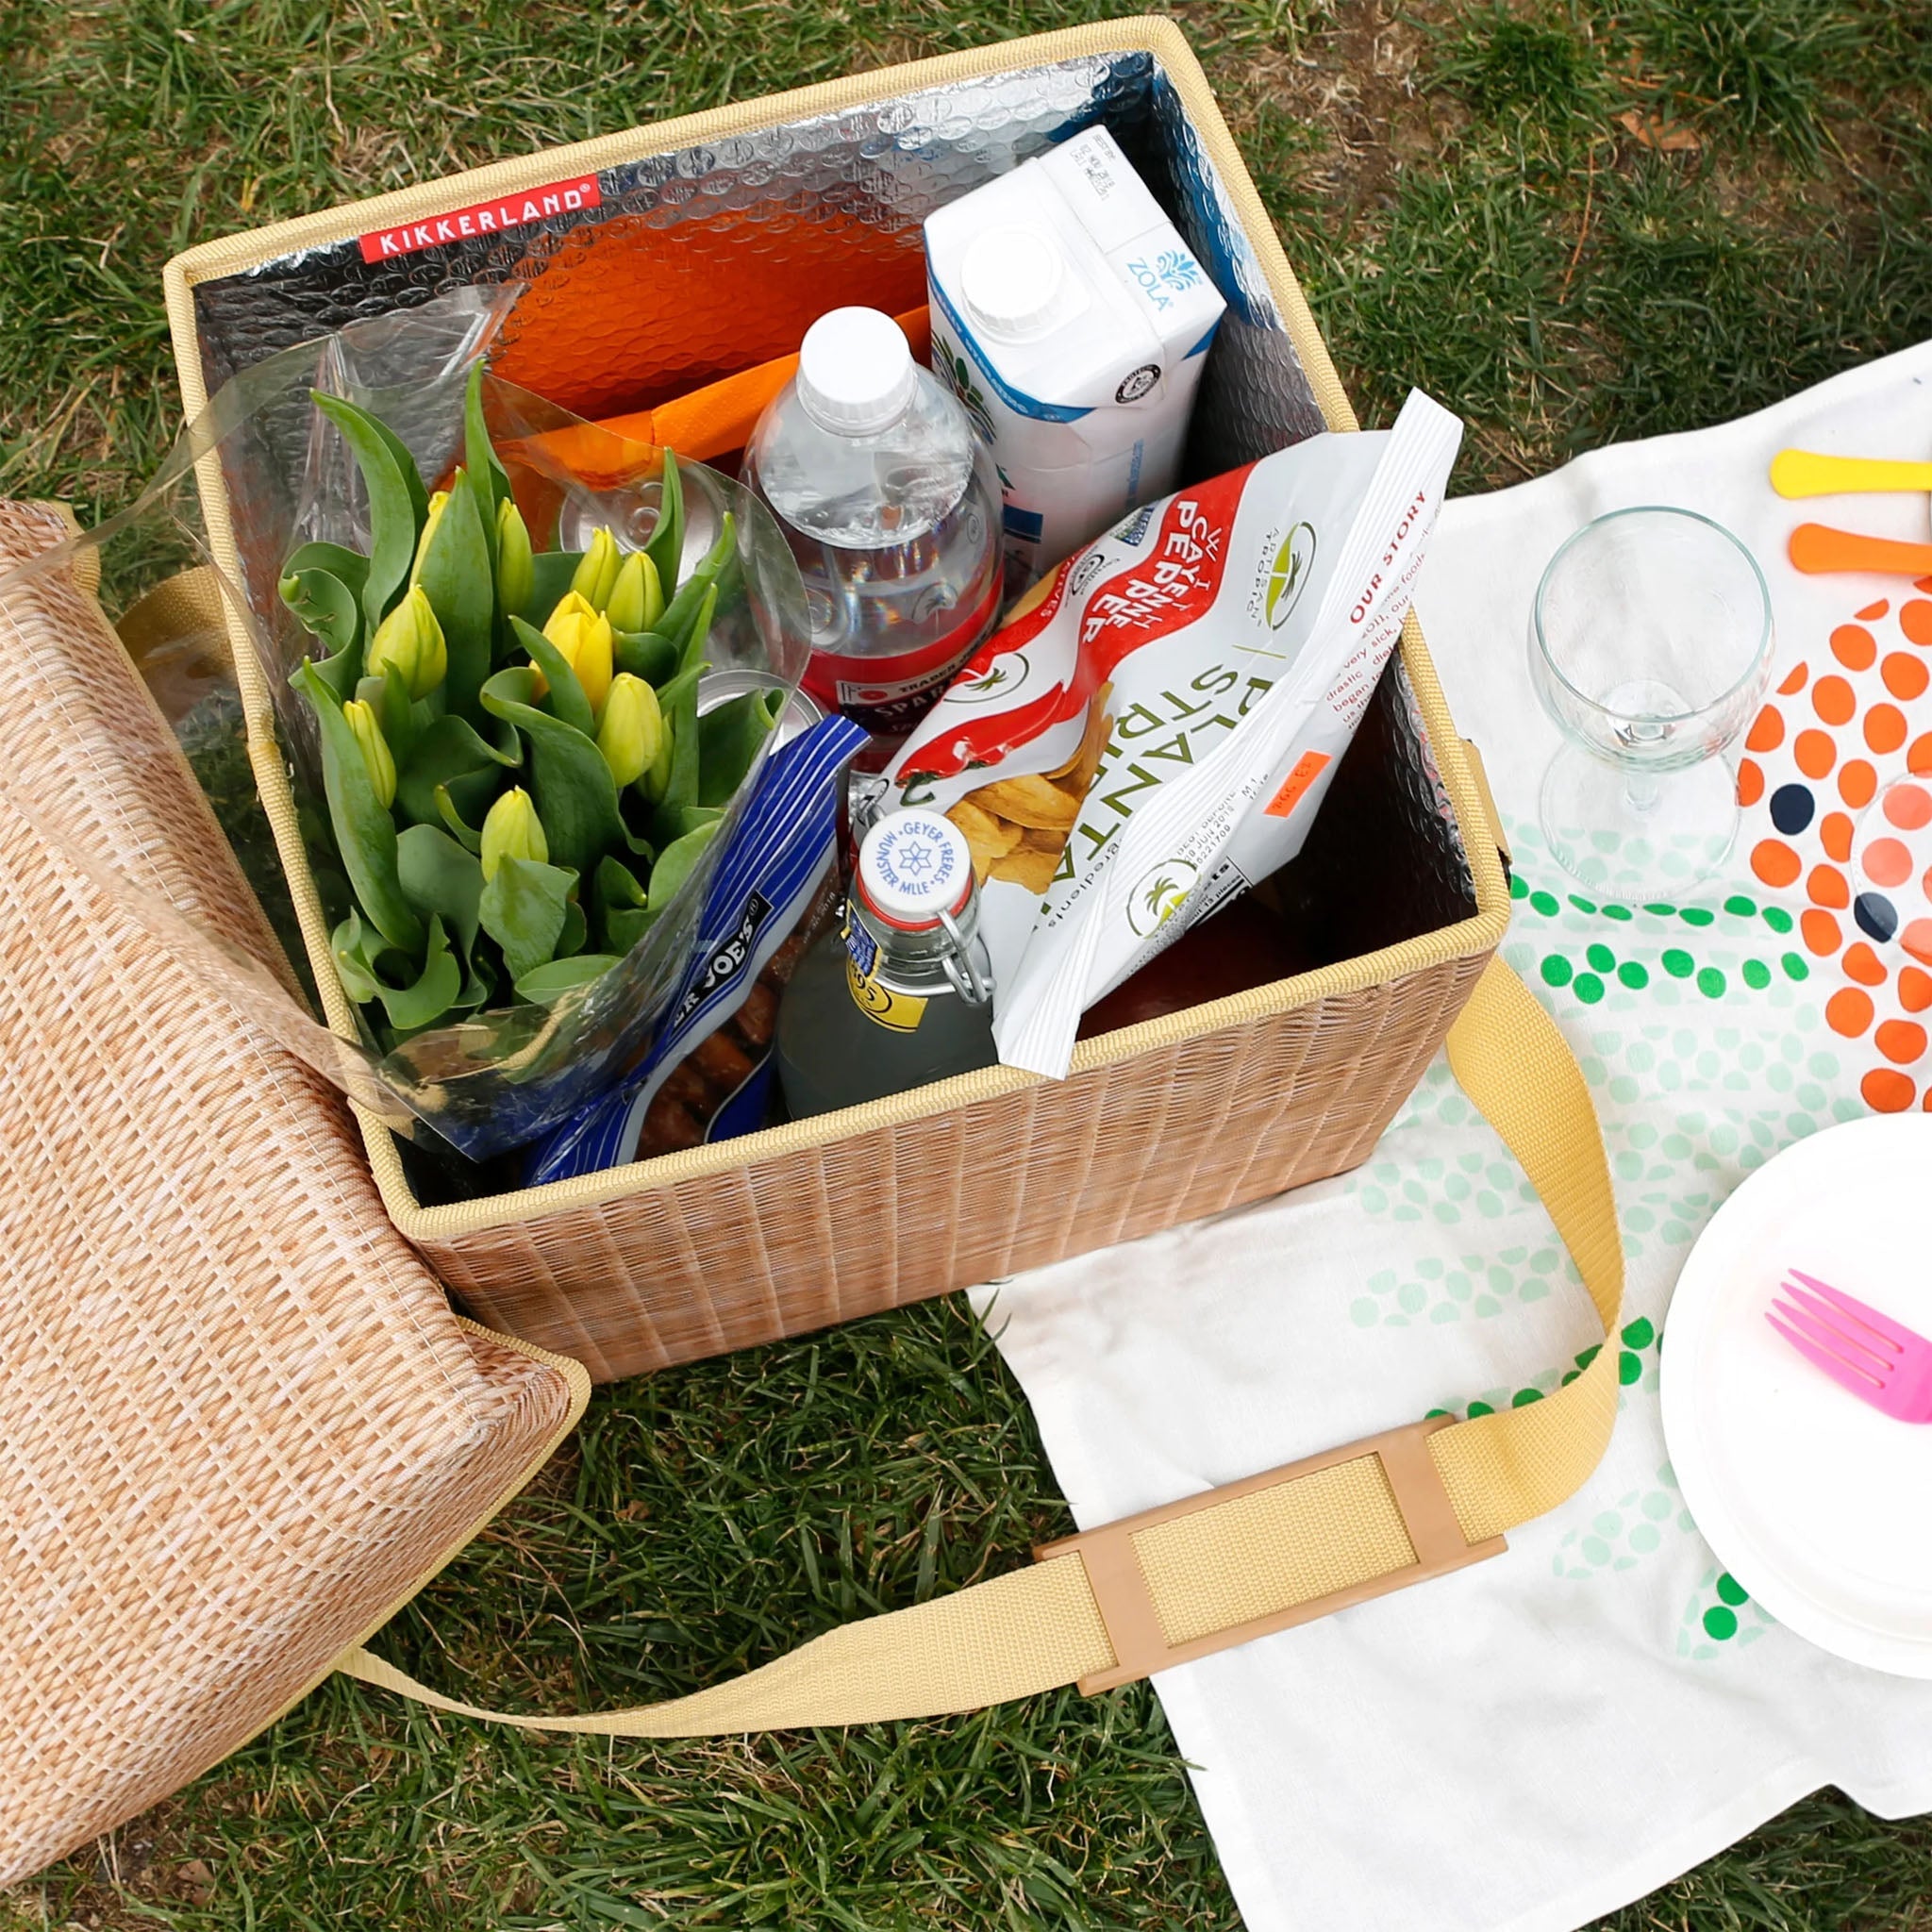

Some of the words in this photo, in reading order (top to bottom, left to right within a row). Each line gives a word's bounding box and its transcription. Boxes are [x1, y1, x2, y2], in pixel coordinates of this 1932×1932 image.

[379, 189, 583, 255] KIKKERLAND
[1125, 257, 1171, 312] ZOLA
[1082, 500, 1198, 643] PEPPER
[1105, 516, 1208, 629] CAYENNE
[1349, 573, 1383, 625] OUR
[1382, 490, 1427, 567] STORY
[1325, 671, 1364, 702] drastic
[1332, 683, 1370, 713] began
[1041, 676, 1274, 915] PLANTA
[874, 830, 900, 888] MUNSTER
[898, 880, 931, 896] MLLE
[903, 821, 943, 843] GEYER
[932, 841, 956, 885] FRERES
[704, 916, 754, 989] JOE'S
